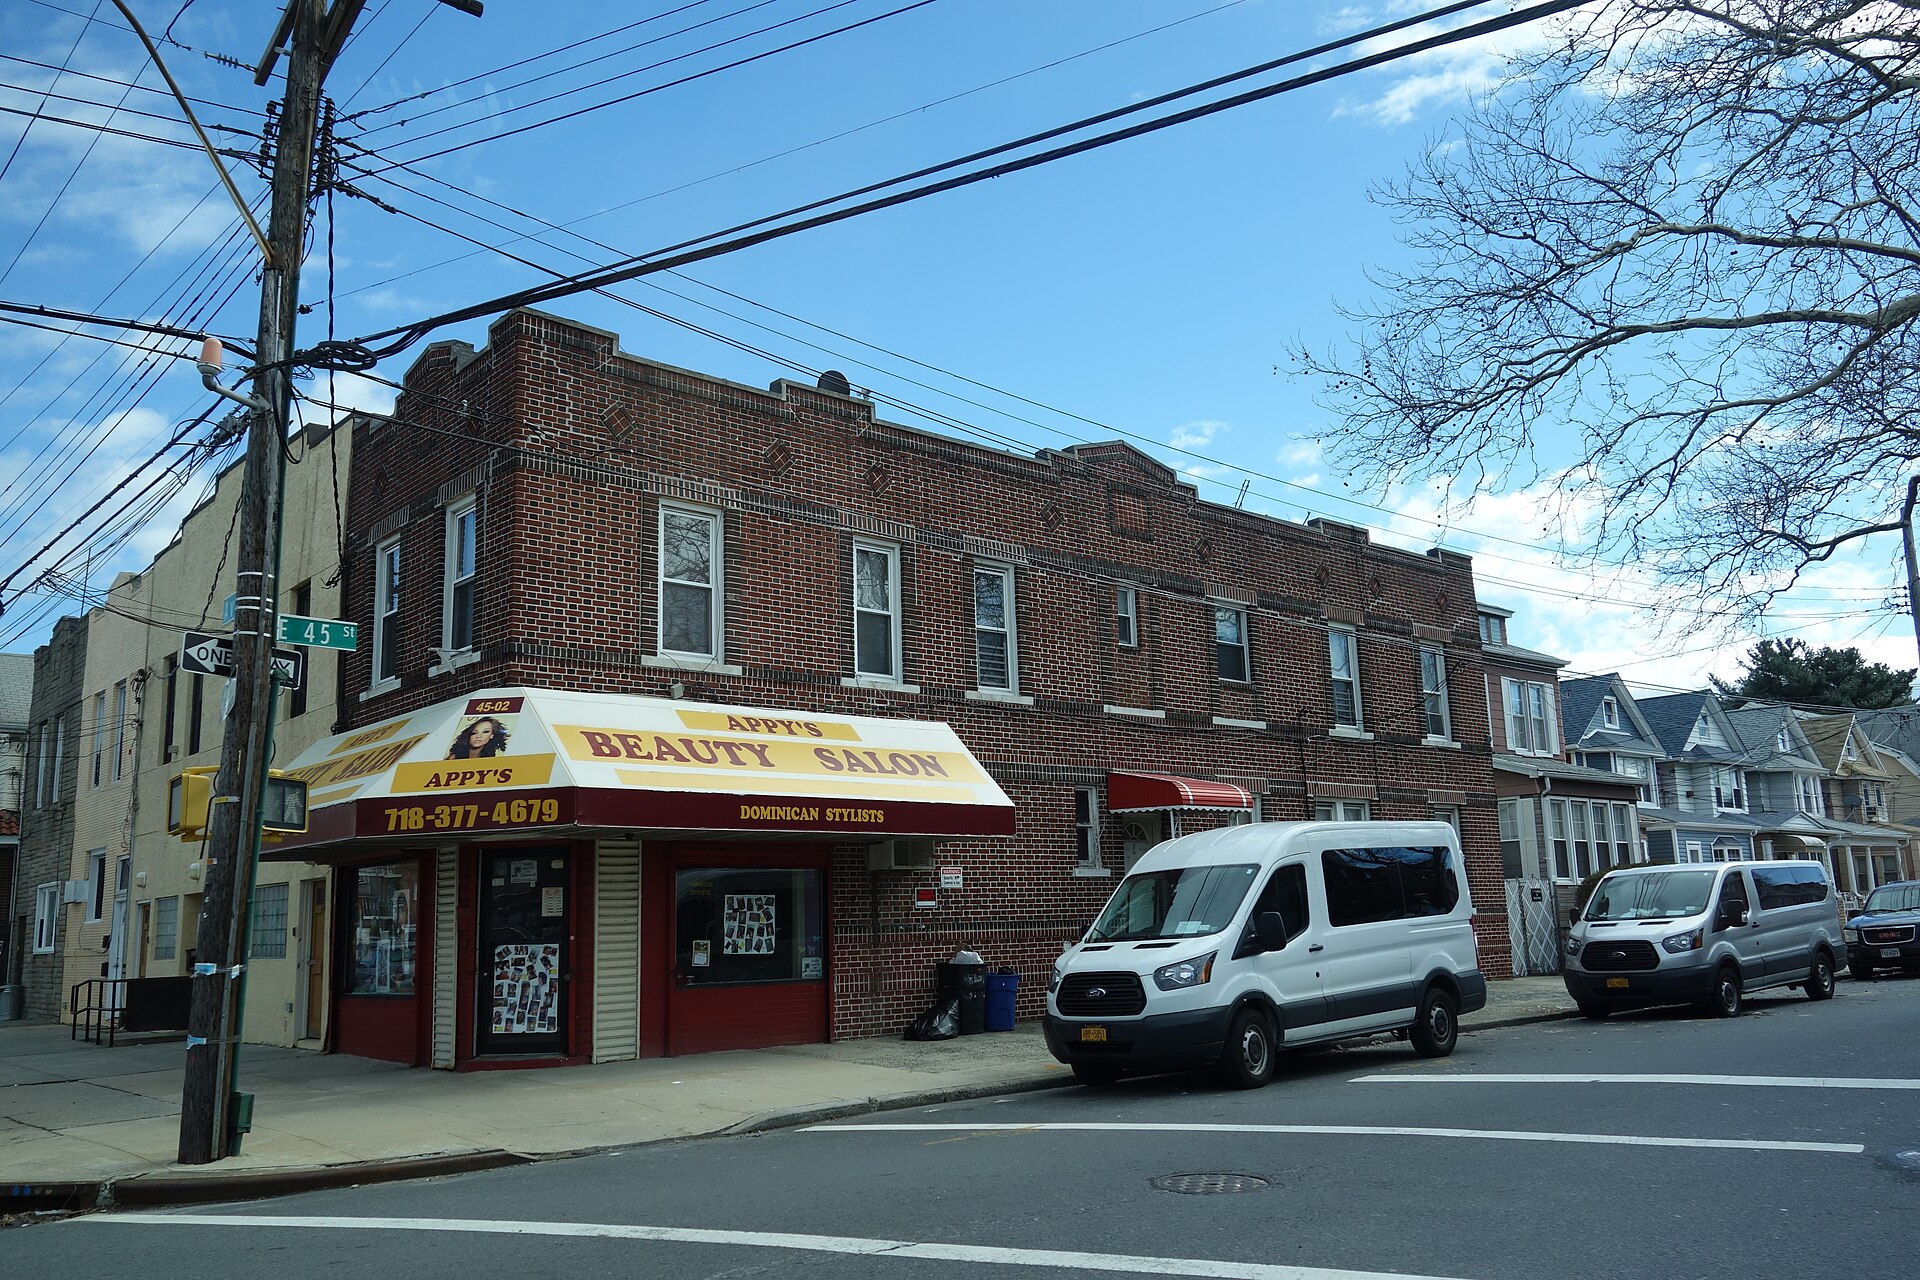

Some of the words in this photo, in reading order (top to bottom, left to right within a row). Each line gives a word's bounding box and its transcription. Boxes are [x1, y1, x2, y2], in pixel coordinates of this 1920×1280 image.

[278, 618, 288, 640] E
[304, 622, 330, 645] 45
[343, 626, 355, 638] St
[197, 646, 233, 666] ONE
[475, 700, 510, 713] 45-02
[727, 714, 824, 738] APPY'S
[579, 730, 776, 768] BEAUTY
[813, 747, 950, 778] SALON
[423, 768, 513, 788] APPY'S
[384, 799, 559, 832] 718-377-4679
[740, 805, 819, 822] DOMINICAN
[825, 807, 885, 823] STYLISTS
